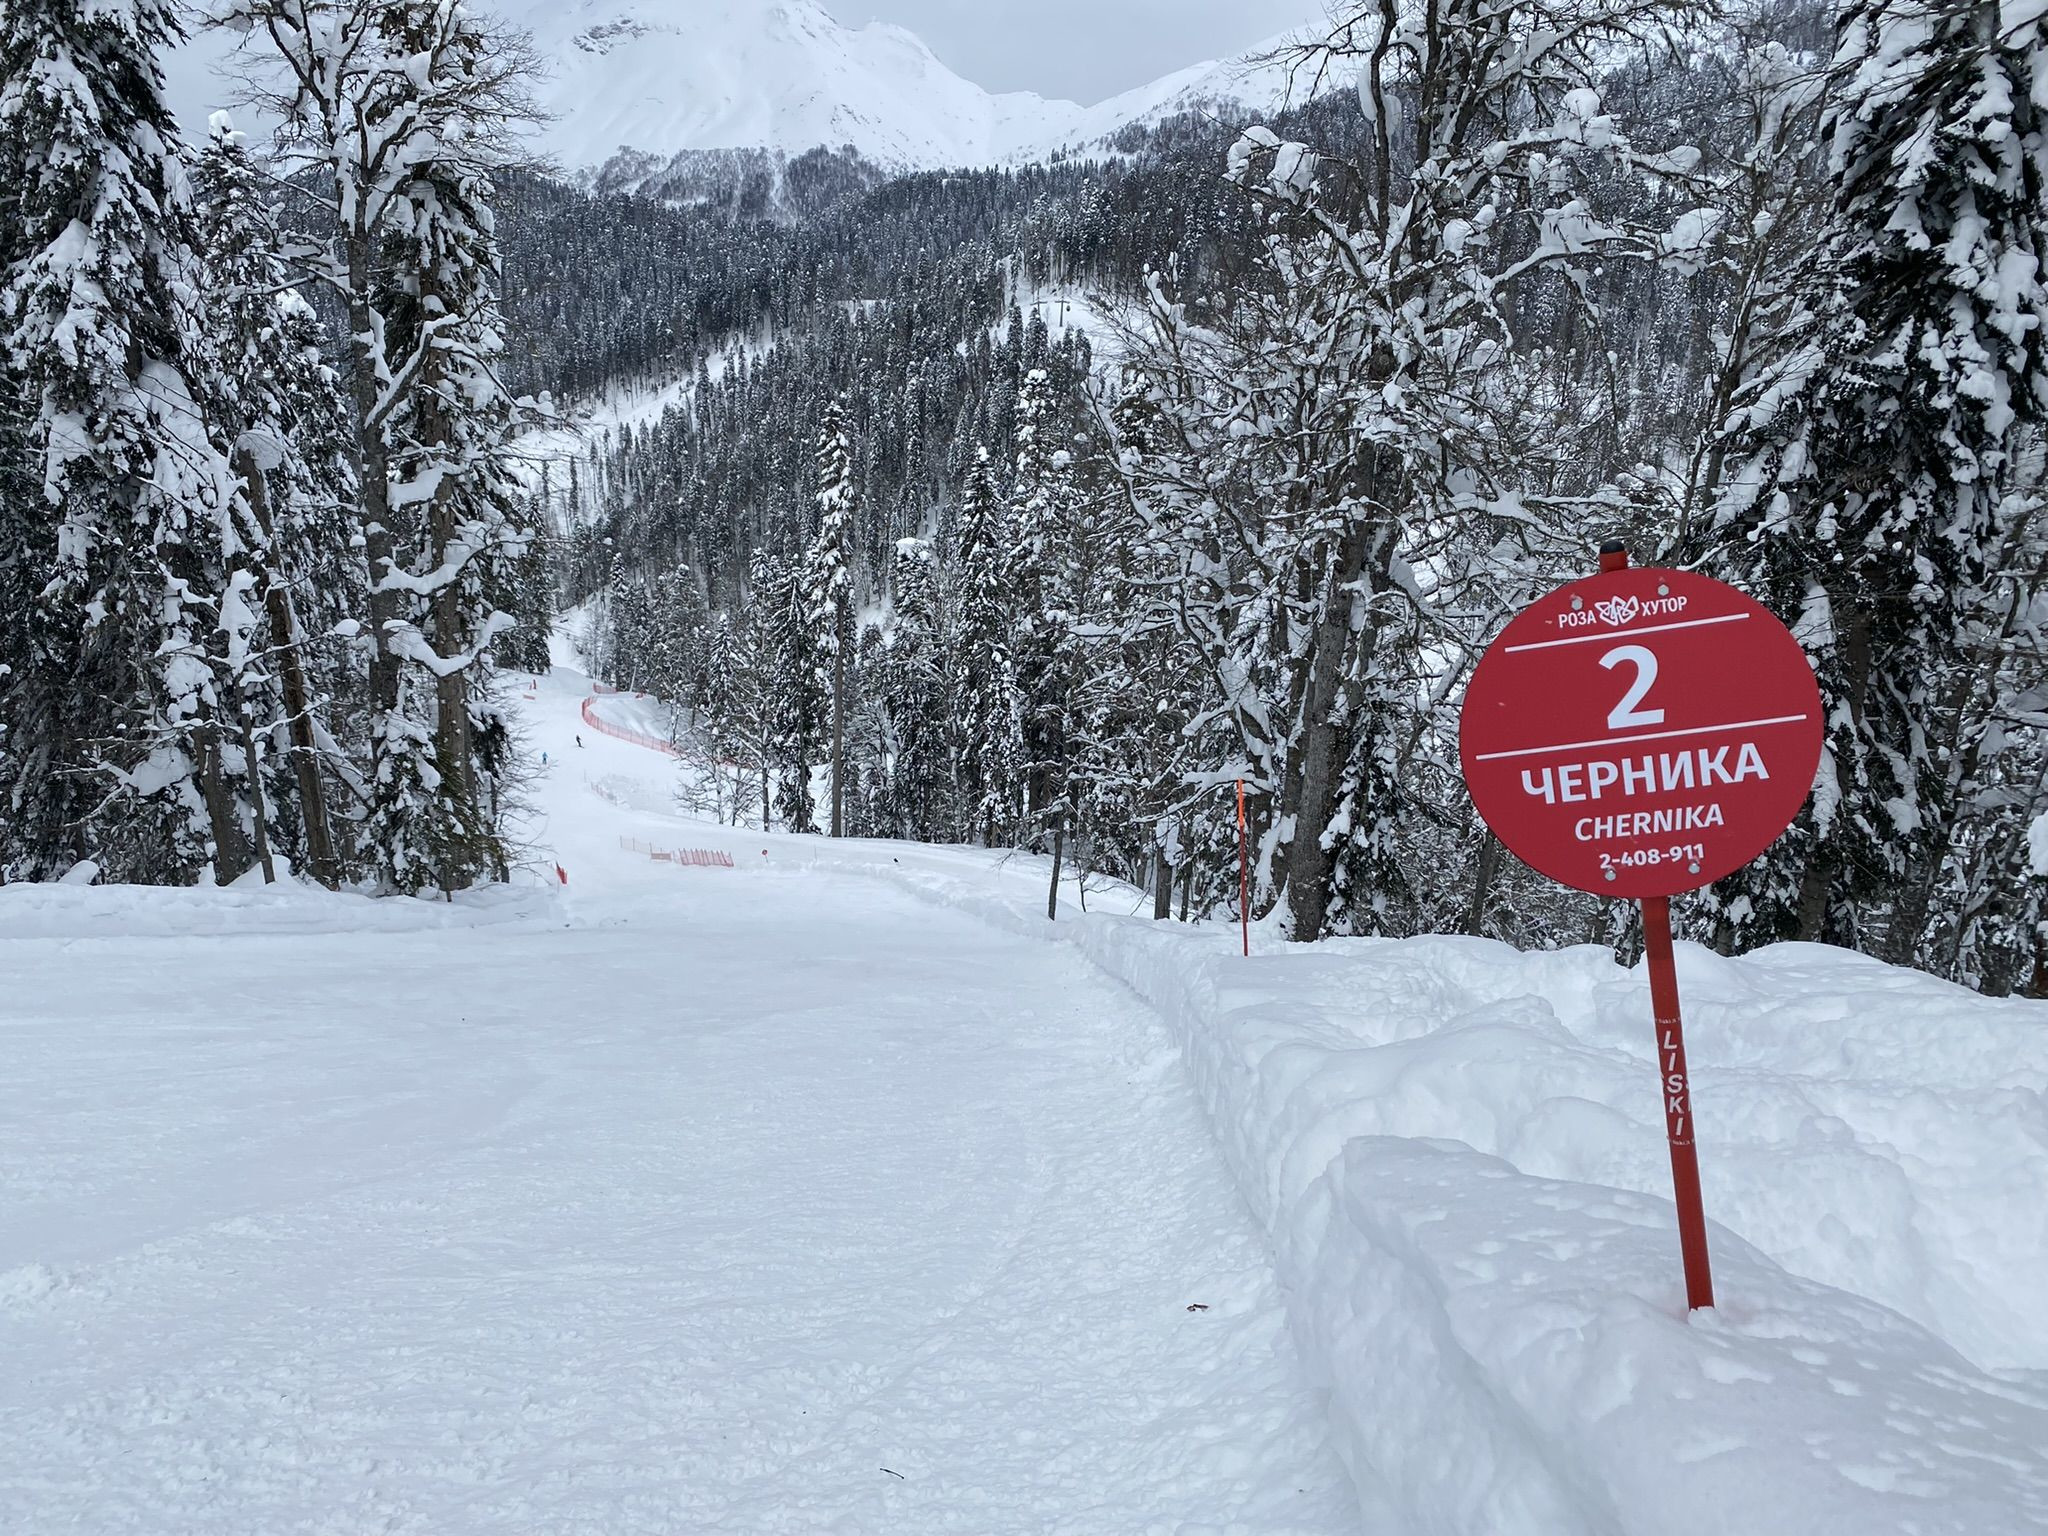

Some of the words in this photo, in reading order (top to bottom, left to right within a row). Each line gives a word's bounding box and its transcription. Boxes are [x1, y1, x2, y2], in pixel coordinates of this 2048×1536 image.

[1558, 610, 1597, 628] РОЗА
[1641, 596, 1687, 616] ХУТОР
[1599, 645, 1664, 729] 2
[1520, 742, 1769, 804] ЧЕРНИКА
[1575, 803, 1724, 841] CHERNIKA
[1599, 843, 1704, 869] 2-408-911
[1663, 1030, 1684, 1136] LISKI
